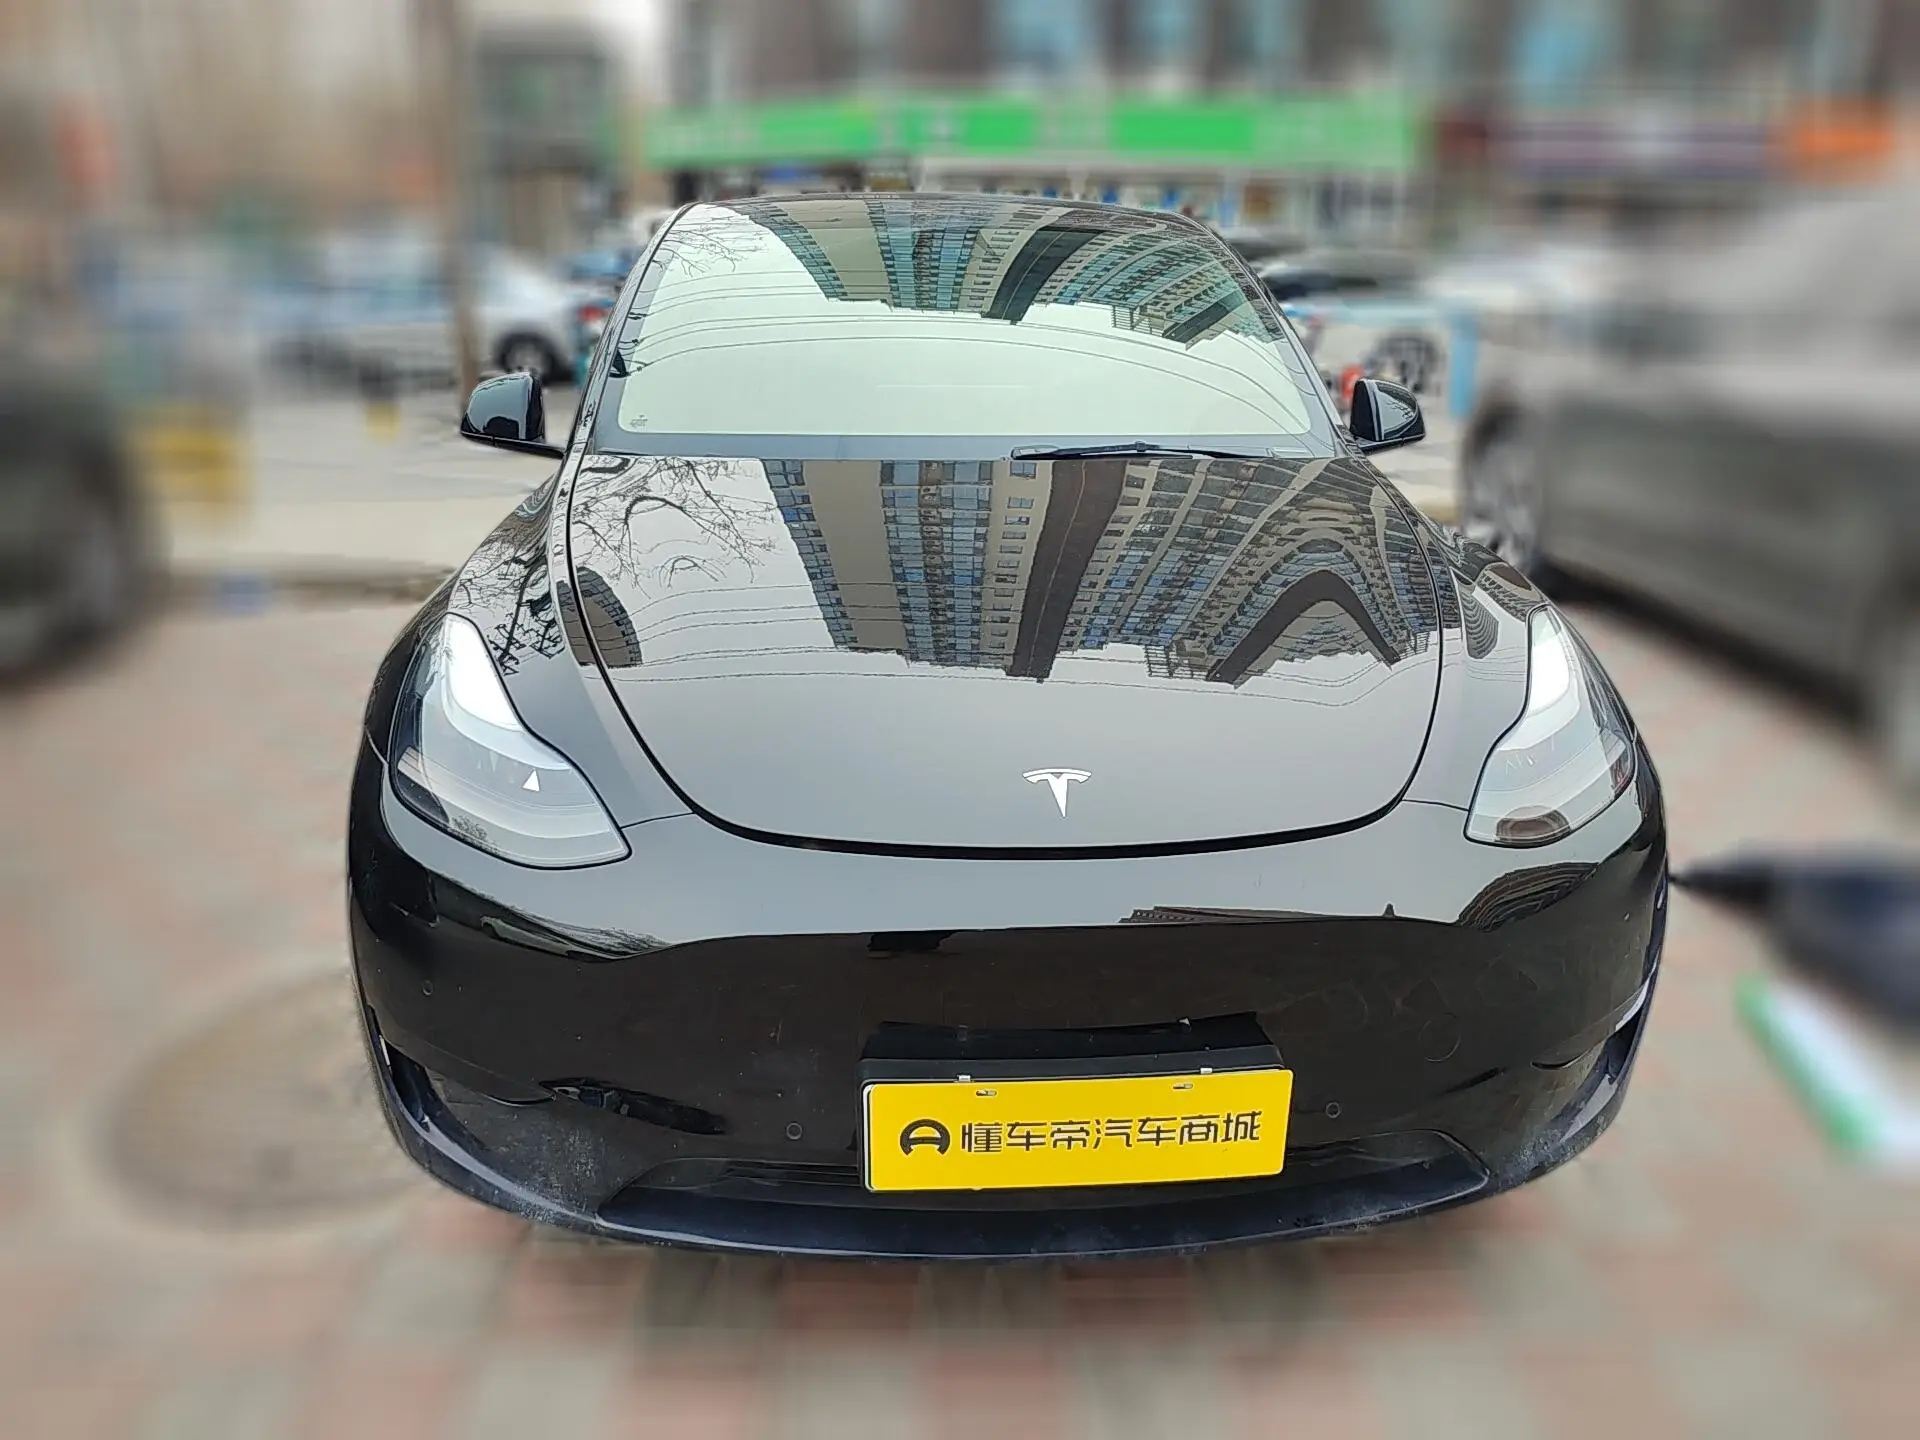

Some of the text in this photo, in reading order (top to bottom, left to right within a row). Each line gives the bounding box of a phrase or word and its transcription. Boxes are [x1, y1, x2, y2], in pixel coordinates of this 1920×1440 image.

[961, 1111, 1262, 1153] 懂车帝汽车商城
